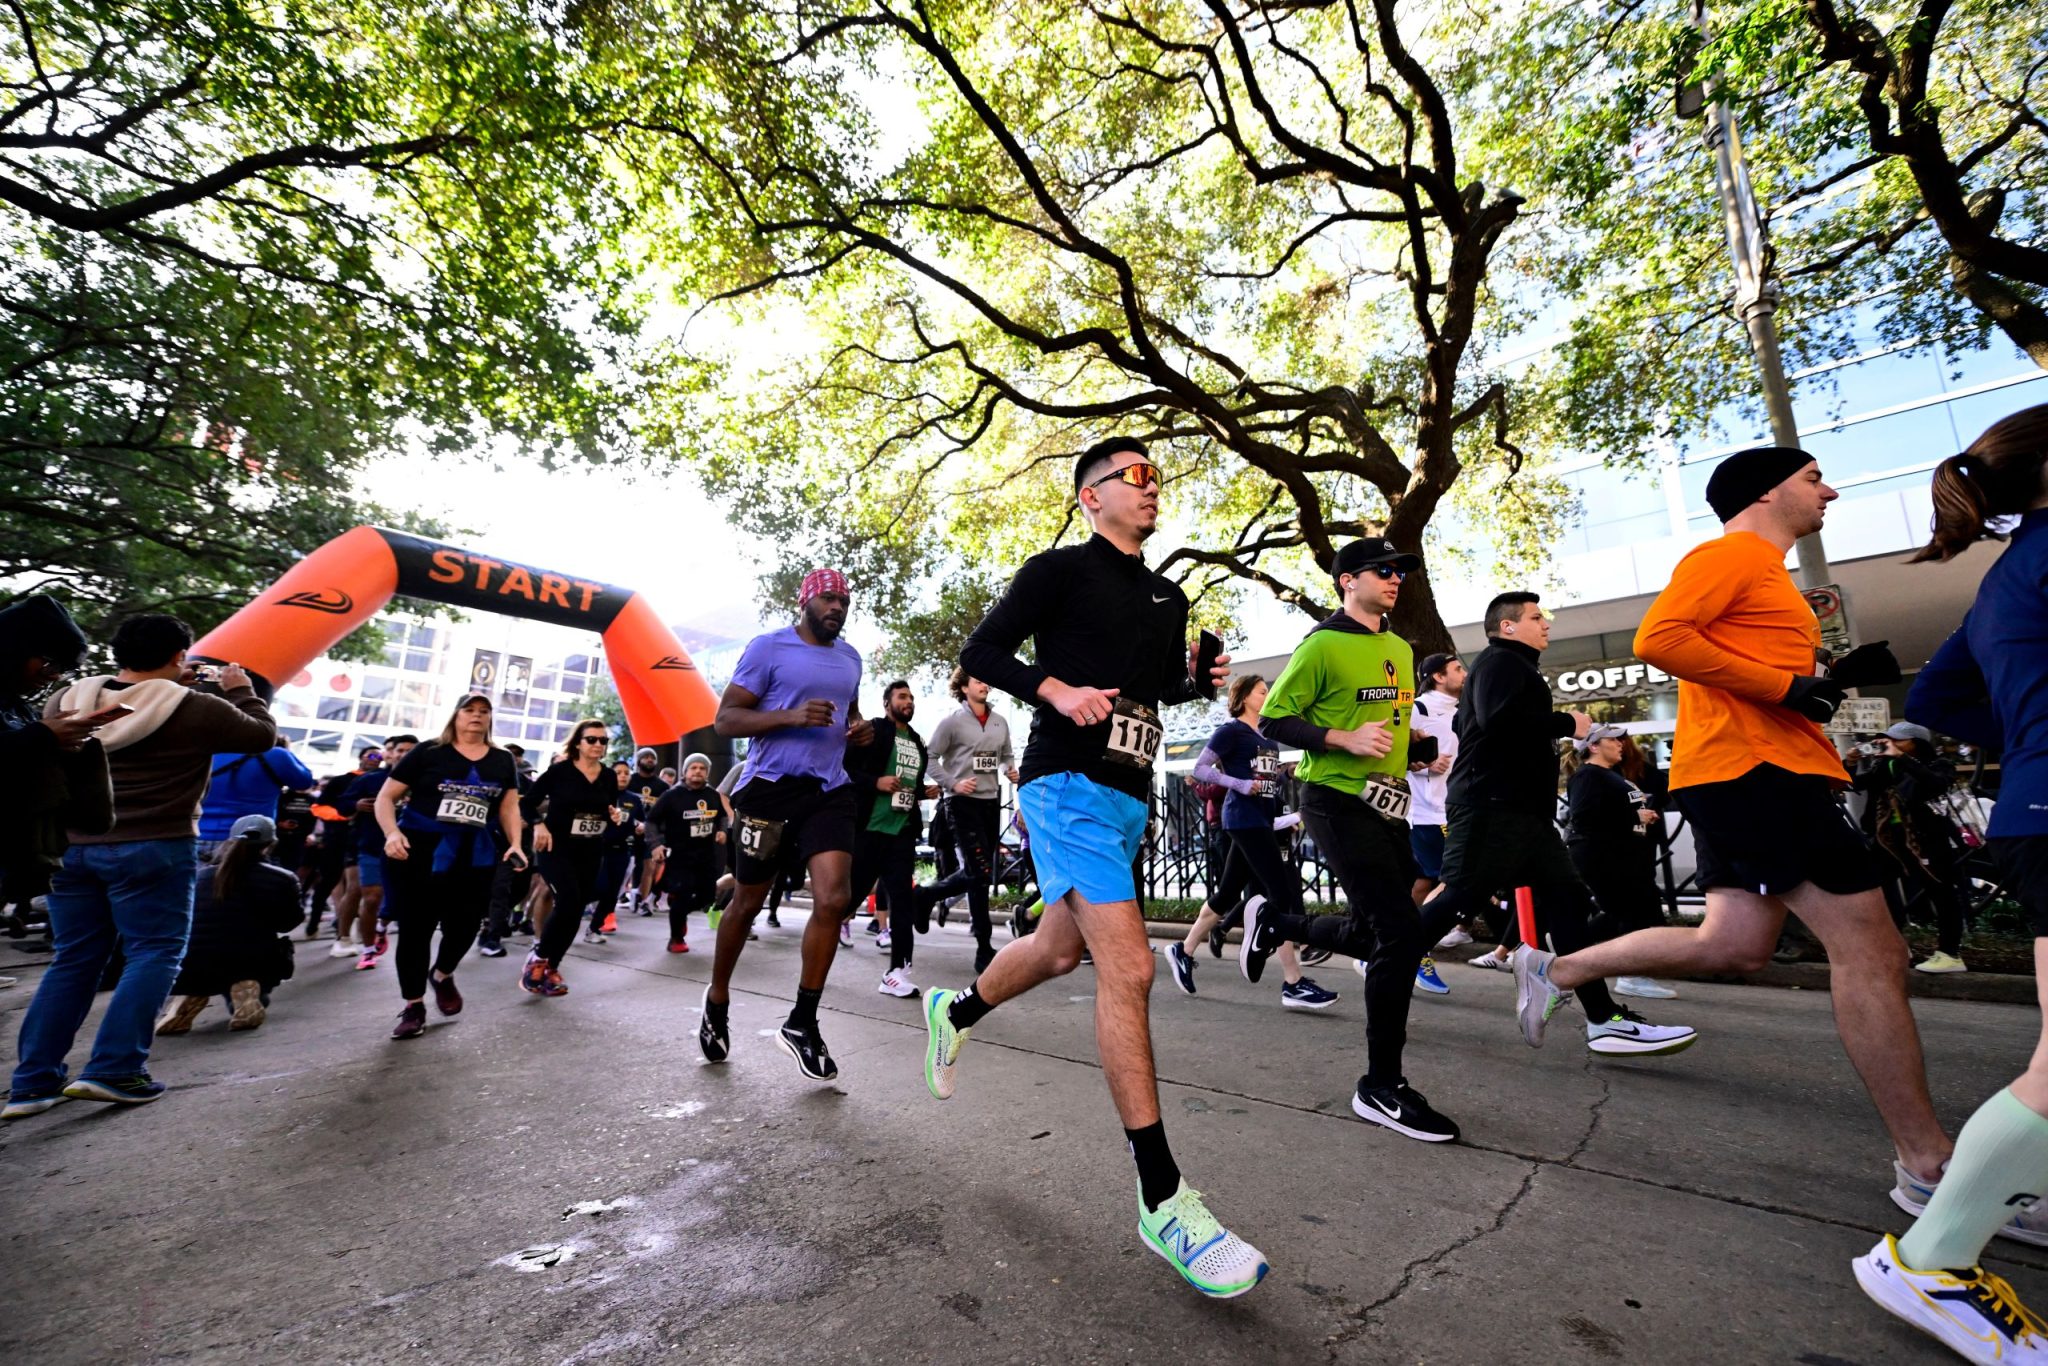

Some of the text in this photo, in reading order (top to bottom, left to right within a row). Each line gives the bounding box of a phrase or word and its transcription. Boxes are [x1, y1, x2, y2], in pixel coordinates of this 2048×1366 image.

[428, 549, 603, 612] START
[1557, 664, 1679, 692] COFFE
[1361, 688, 1398, 700] TROPHY
[1117, 719, 1161, 758] 1182
[896, 752, 920, 768] LIVES
[976, 757, 997, 769] 1694
[444, 801, 486, 820] 1206
[1366, 785, 1409, 816] 1671
[579, 820, 602, 833] 635
[741, 826, 762, 849] 61
